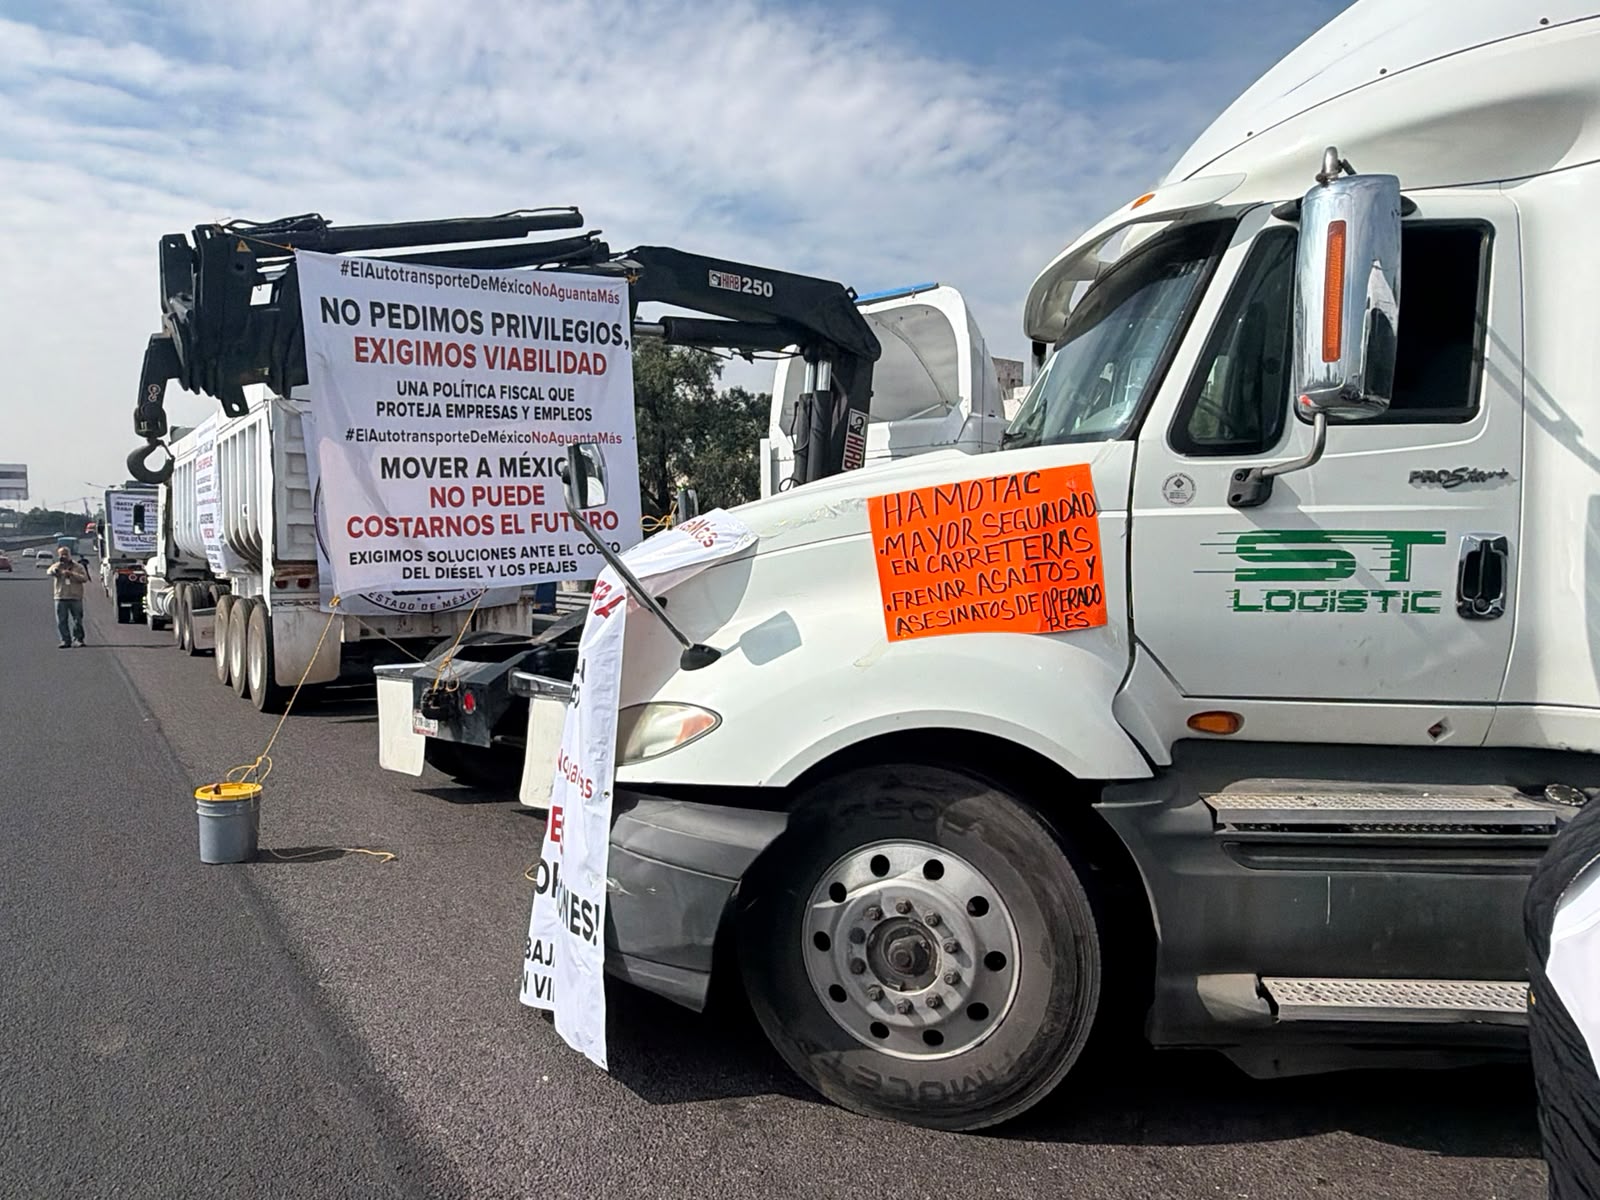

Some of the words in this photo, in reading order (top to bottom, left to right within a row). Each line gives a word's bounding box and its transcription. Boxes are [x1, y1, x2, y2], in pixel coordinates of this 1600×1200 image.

[340, 259, 620, 305] #ElAutotransporteDeMéxicoNoAguantaMás
[721, 273, 740, 291] HIAB
[742, 276, 773, 298] 250
[320, 296, 361, 326] NO
[370, 301, 484, 336] PEDIMOS
[491, 312, 630, 350] PRIVILEGIOS,
[354, 336, 477, 369] EXIGIMOS
[483, 345, 607, 376] VIABILIDAD
[397, 380, 428, 397] UNA
[433, 380, 496, 400] POLÍTICA
[500, 385, 545, 401] FISCAL
[548, 387, 575, 402] QUE
[376, 401, 441, 419] PROTEJA
[446, 403, 518, 420] EMPRESAS
[522, 405, 530, 420] Y
[534, 406, 593, 421] EMPLEOS
[345, 428, 622, 446] #ElAutotransporteDeMéxicoNoAguantaMás
[381, 456, 468, 479] MOVER
[476, 456, 492, 478] A
[499, 451, 568, 478] MÉXIC
[430, 486, 464, 508] NO
[472, 485, 545, 507] PUEDE
[347, 514, 494, 538] COSTARNOS
[501, 513, 525, 535] EL
[982, 492, 1097, 538] SEGURIDAD
[349, 549, 423, 565] EXIGIMOS
[427, 547, 516, 563] SOLUCIONES
[520, 544, 555, 559] ANTE
[559, 543, 573, 557] EL
[577, 541, 621, 555] COO
[891, 556, 920, 576] EN
[927, 526, 1094, 574] CARRETERAS
[1218, 529, 1447, 582] ST
[402, 567, 430, 580] DEL
[435, 564, 483, 579] DIÉSEL
[488, 565, 496, 578] Y
[500, 563, 526, 577] LOS
[529, 560, 578, 575] PEAJES
[977, 558, 1080, 596] ASALTOS
[1085, 555, 1096, 580] Y
[368, 591, 415, 610] ESTADO
[421, 603, 436, 611] DE
[442, 588, 479, 609] MÉXIC
[896, 599, 1015, 636] ASESINATOS
[1015, 591, 1039, 616] DE
